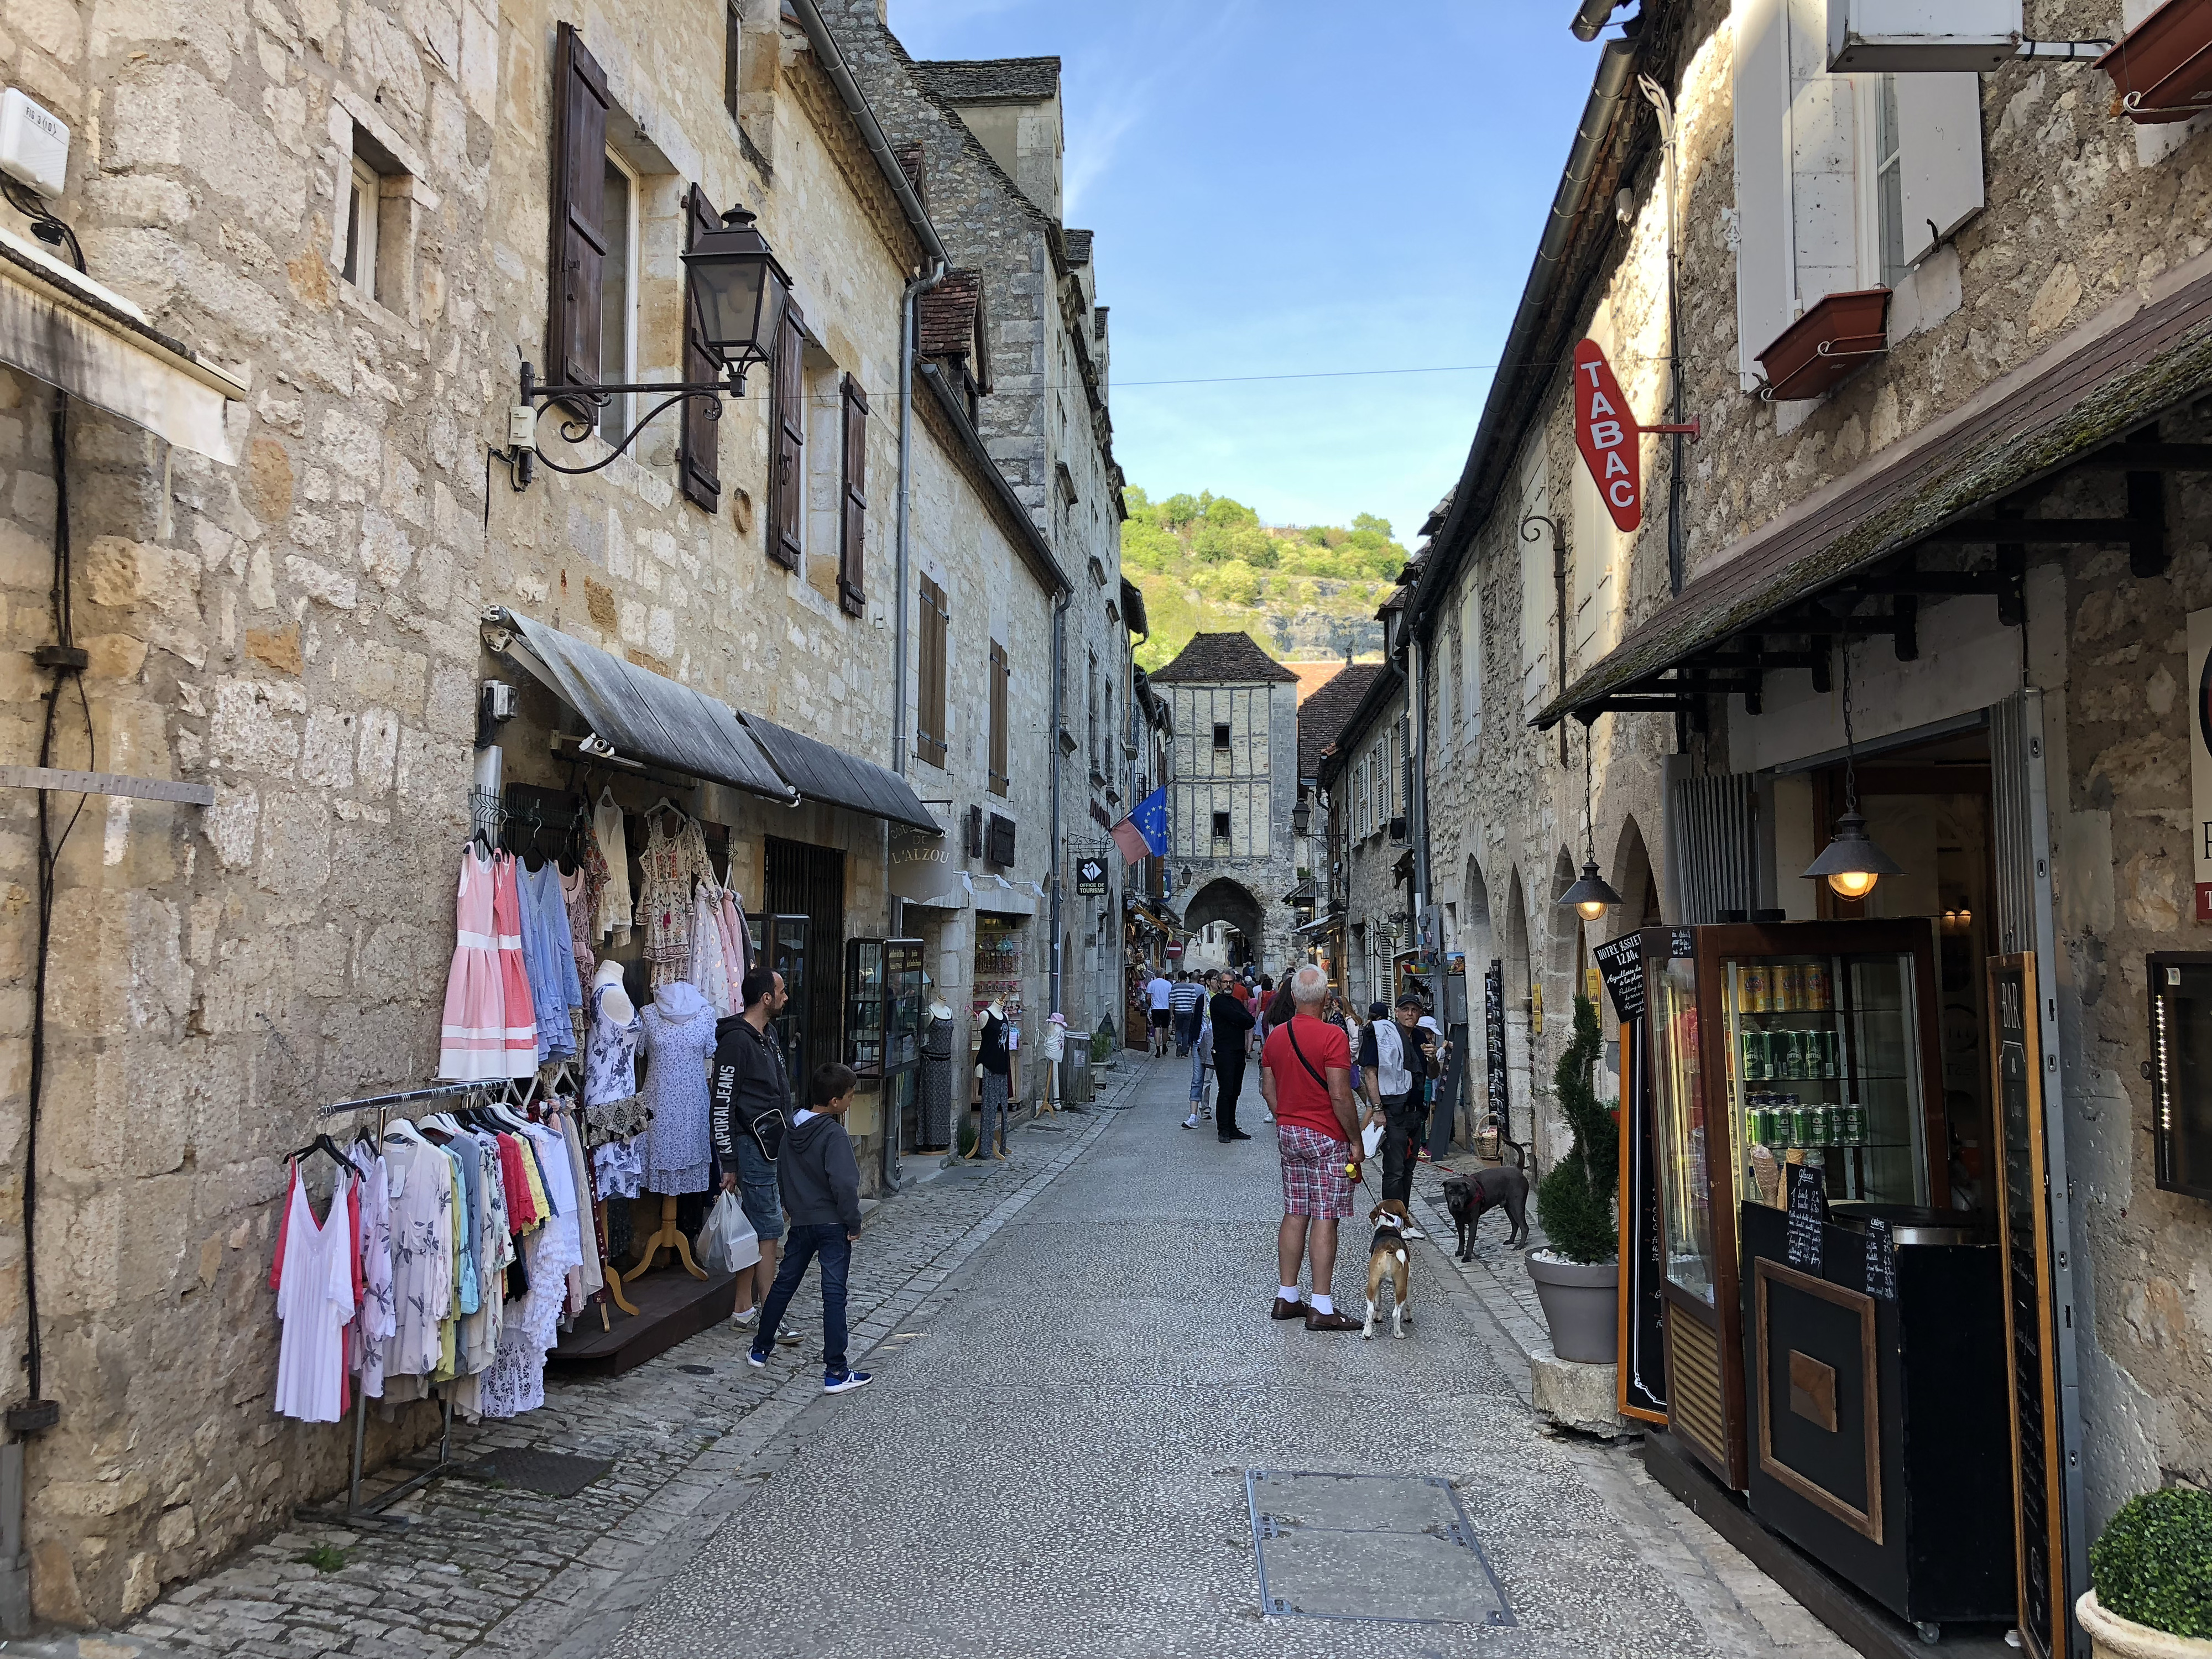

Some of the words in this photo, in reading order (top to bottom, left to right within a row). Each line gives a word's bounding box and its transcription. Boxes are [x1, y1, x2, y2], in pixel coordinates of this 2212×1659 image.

[1580, 360, 1634, 508] TABAC
[891, 848, 950, 864] L'ALZOU
[1597, 943, 1619, 961] NOTRE
[2002, 982, 2021, 1030] BAR
[716, 1065, 735, 1103] JEANS
[713, 1104, 733, 1155] KAPORAL
